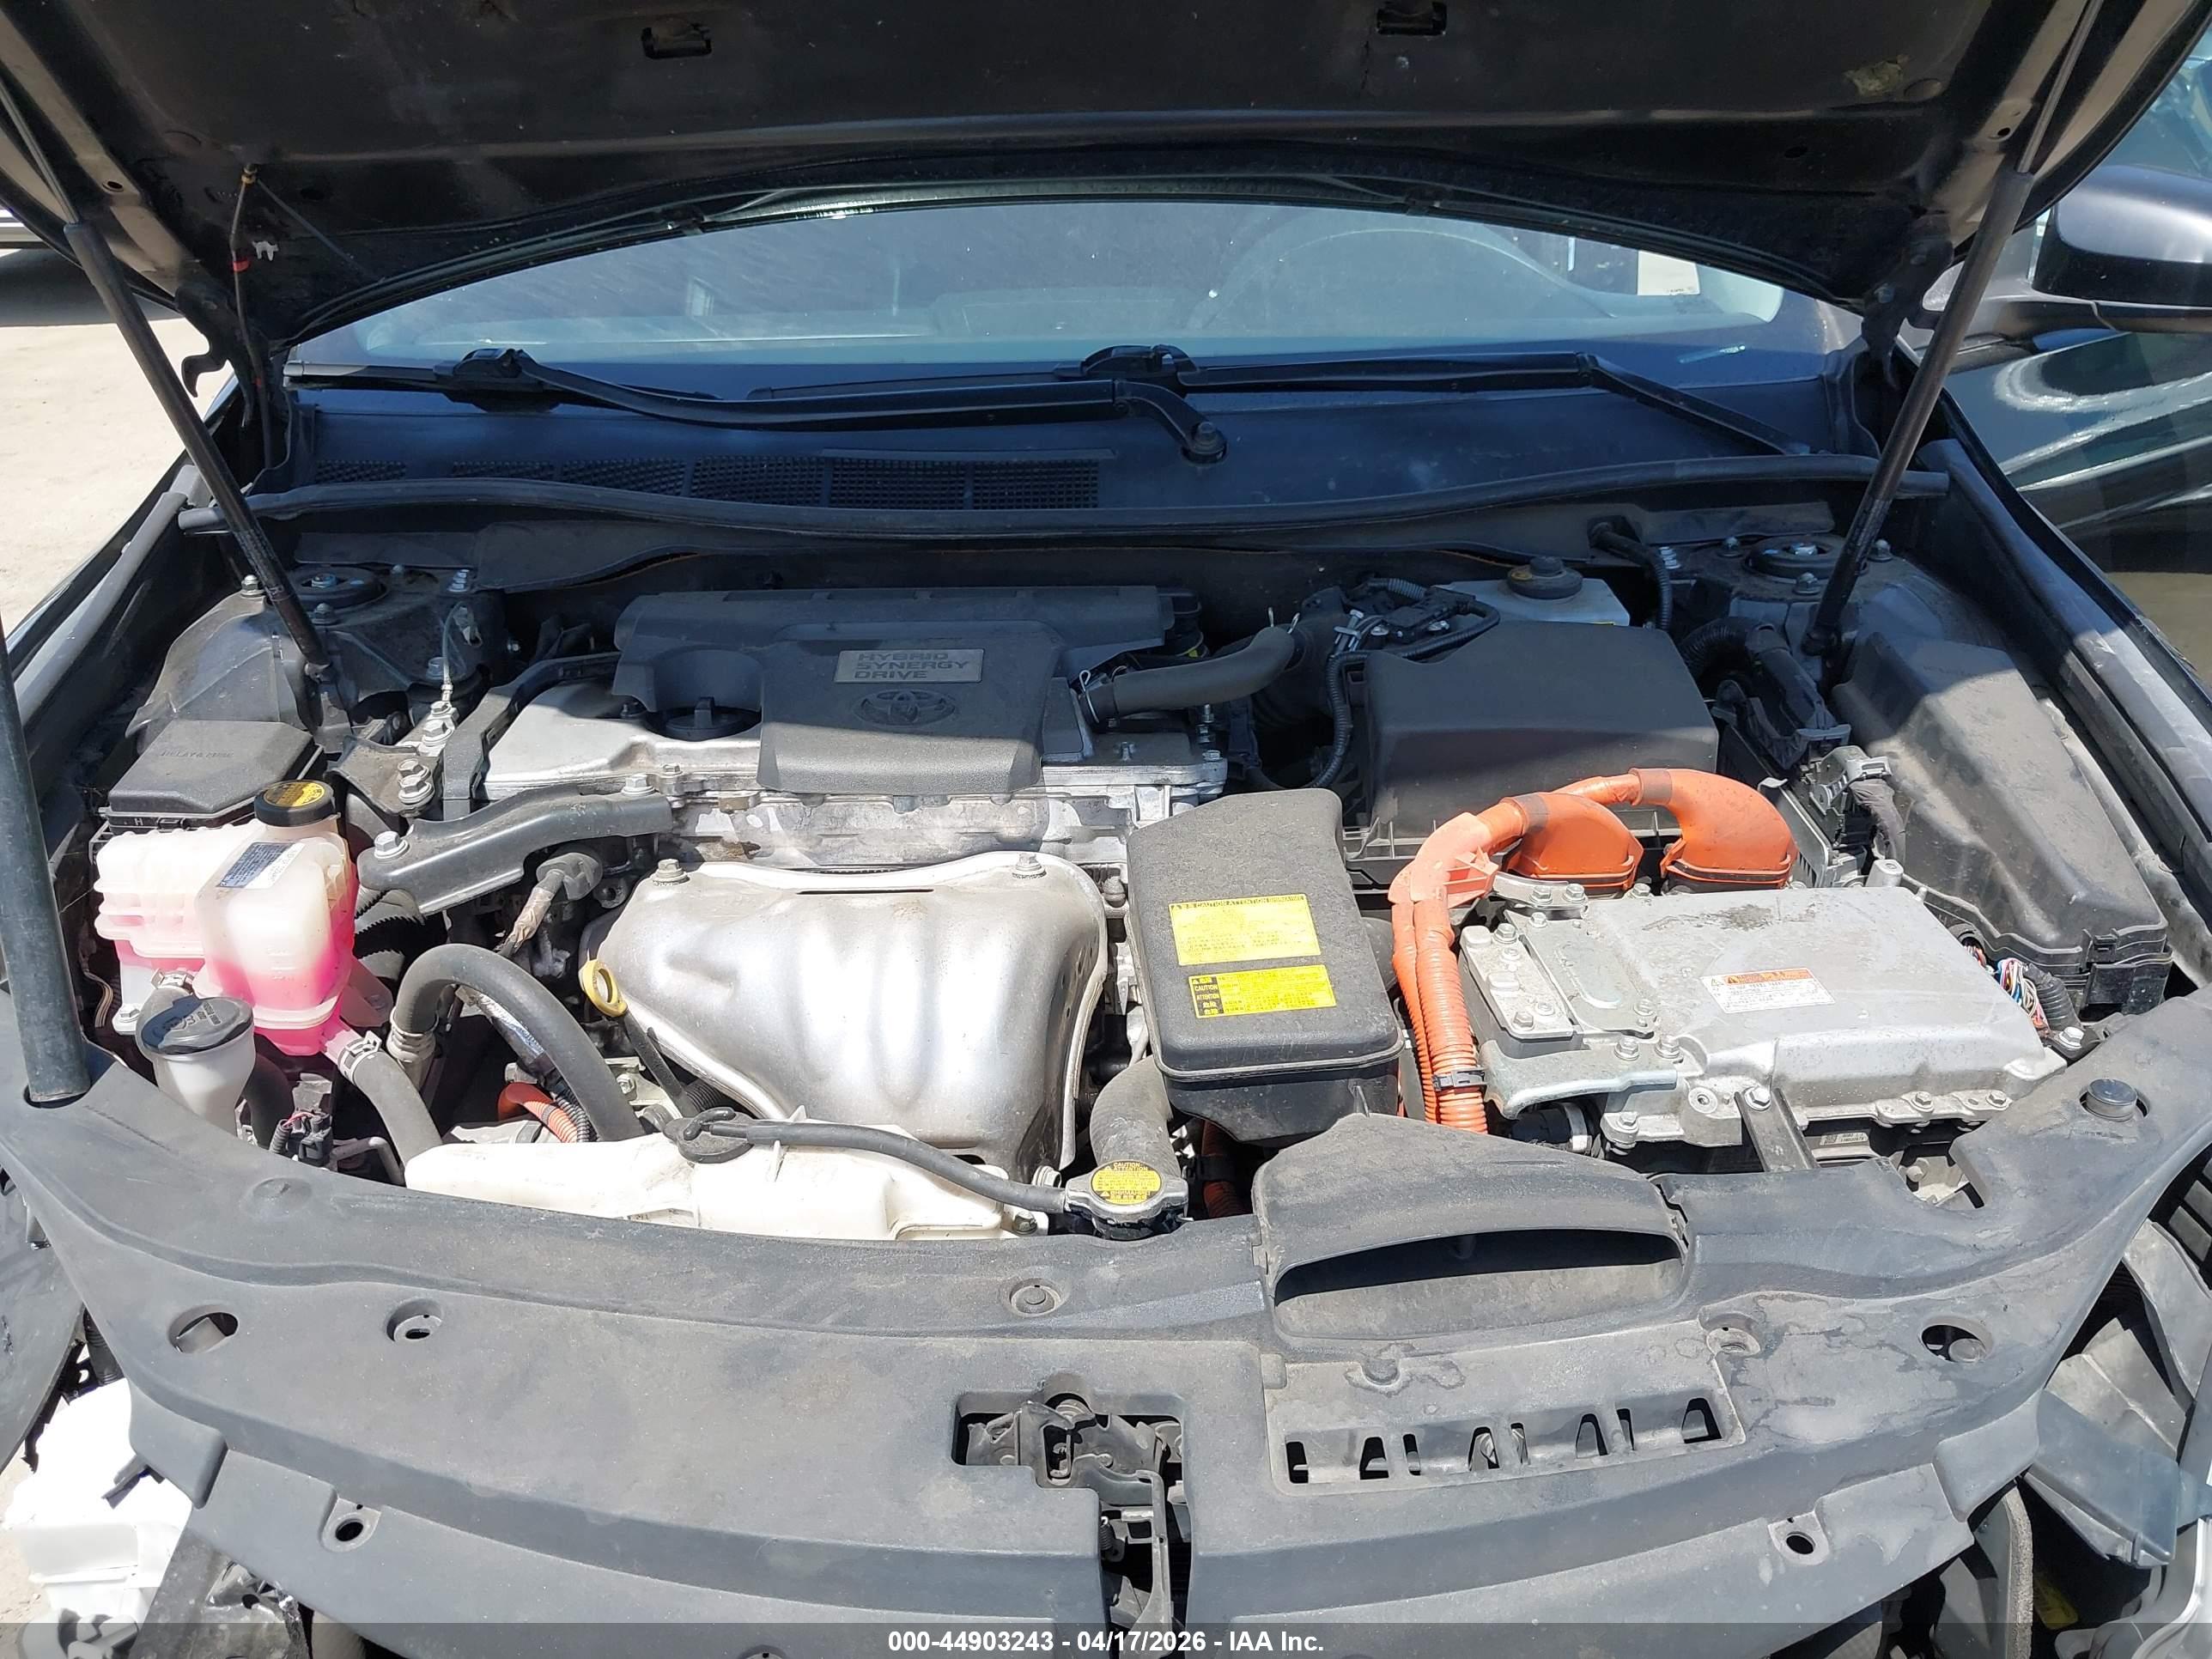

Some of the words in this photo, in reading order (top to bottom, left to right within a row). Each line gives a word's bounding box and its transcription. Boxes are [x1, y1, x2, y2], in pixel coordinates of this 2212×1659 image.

[856, 660, 969, 670] SYNERGY
[854, 670, 928, 679] DRIVE
[134, 817, 143, 826] H
